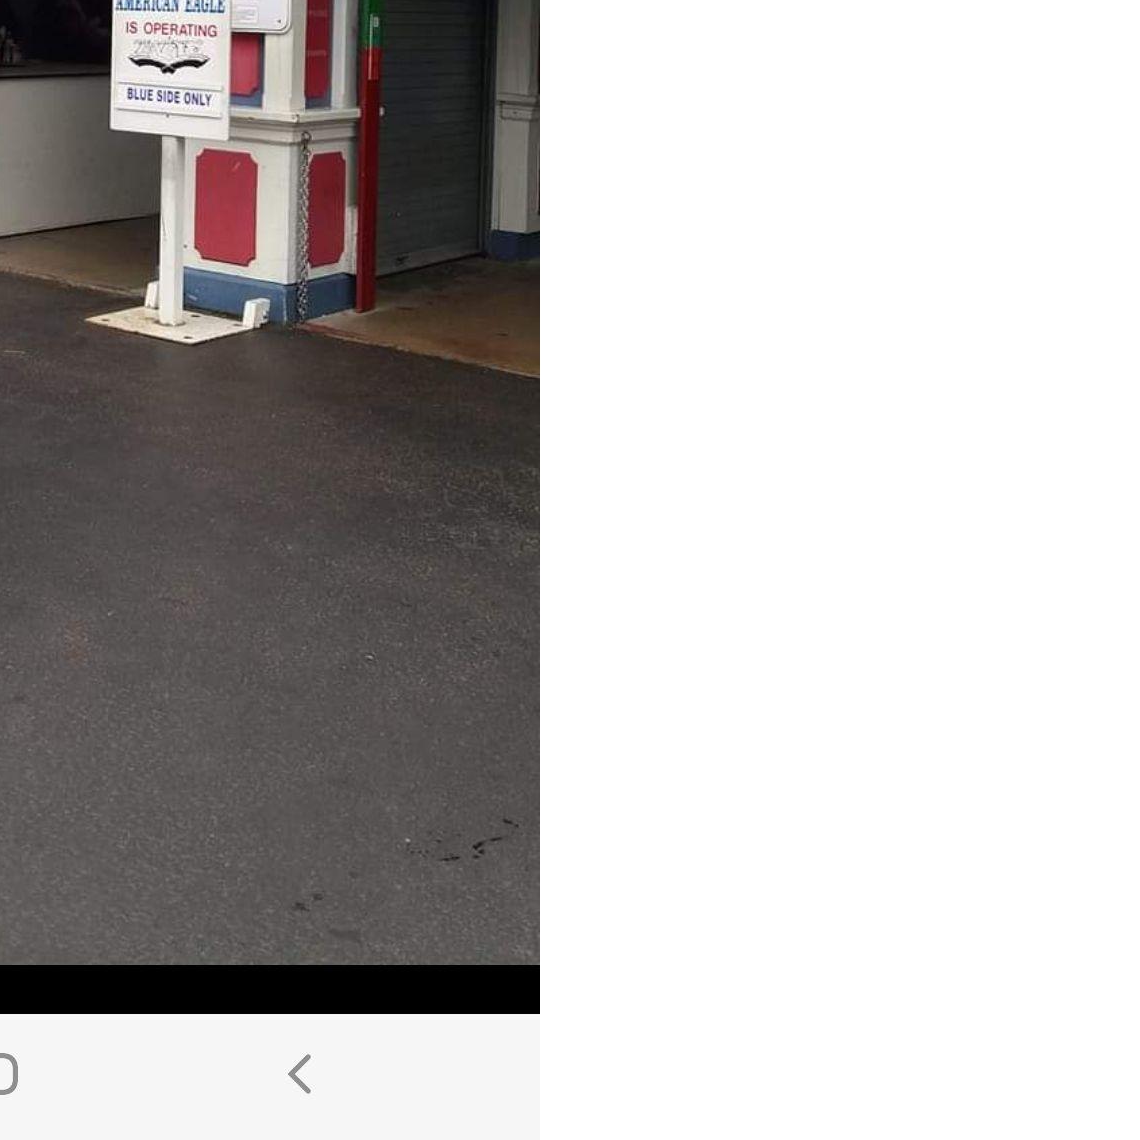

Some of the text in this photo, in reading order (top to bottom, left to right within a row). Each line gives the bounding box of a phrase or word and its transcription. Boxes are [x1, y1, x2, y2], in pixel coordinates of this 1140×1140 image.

[126, 21, 218, 38] IS OPERATING
[127, 88, 212, 106] BLUE SIDE ONLY
